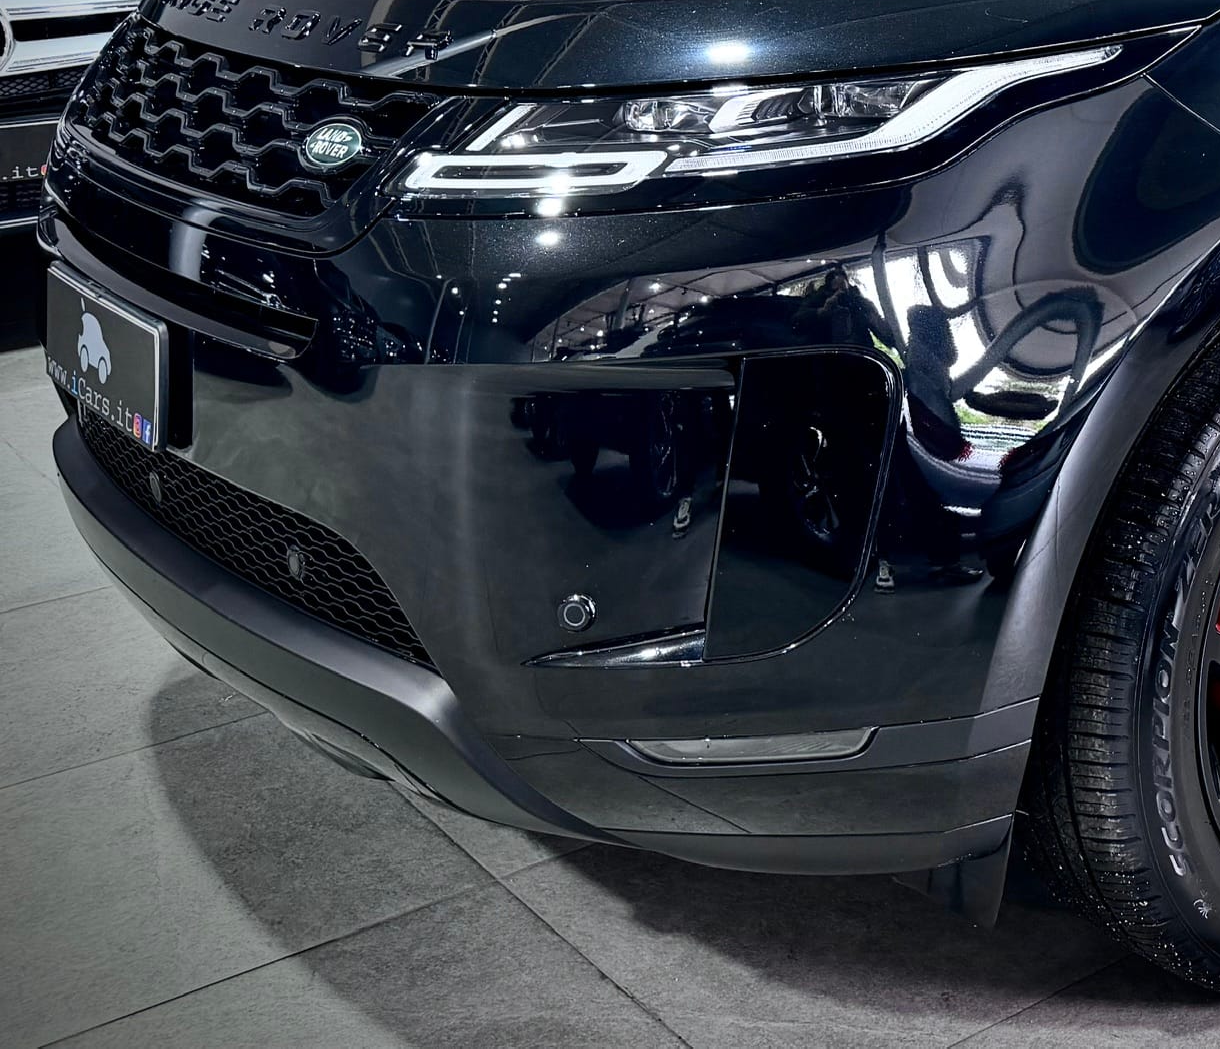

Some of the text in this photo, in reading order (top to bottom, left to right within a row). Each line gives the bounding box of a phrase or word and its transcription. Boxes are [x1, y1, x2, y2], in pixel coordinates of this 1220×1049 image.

[249, 4, 453, 60] ROVER
[311, 140, 349, 159] ROVER
[316, 127, 348, 143] LAND
[1152, 617, 1196, 877] SCORPION
